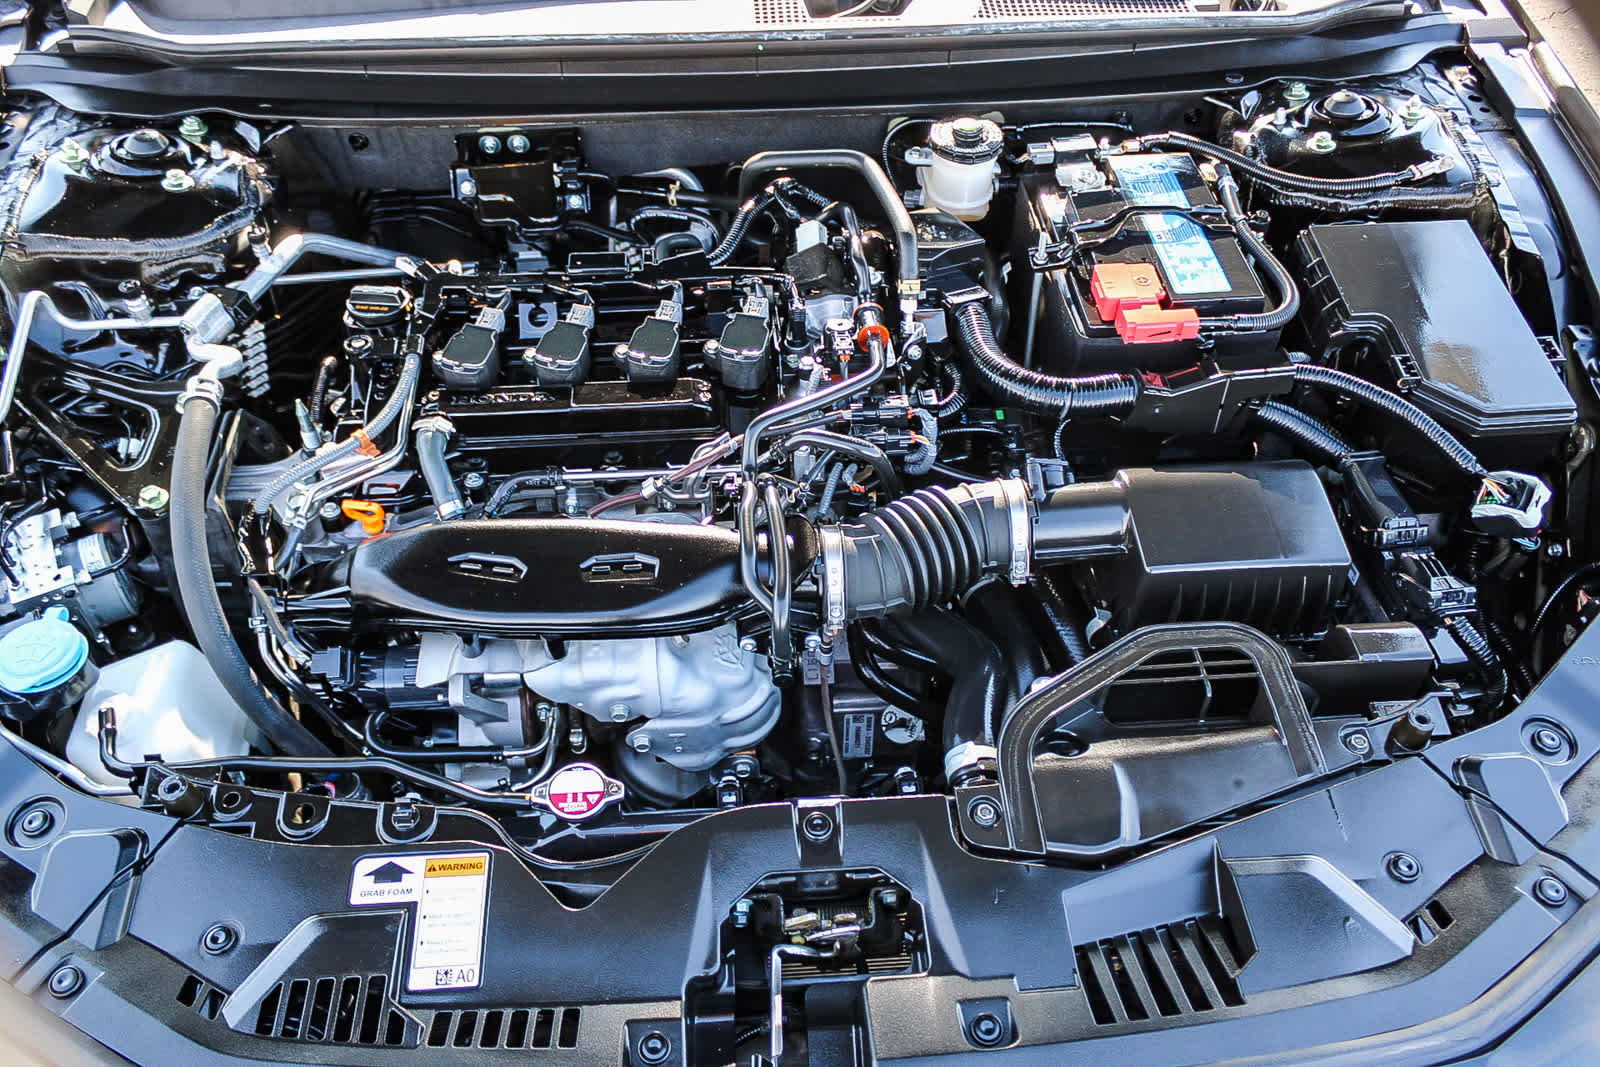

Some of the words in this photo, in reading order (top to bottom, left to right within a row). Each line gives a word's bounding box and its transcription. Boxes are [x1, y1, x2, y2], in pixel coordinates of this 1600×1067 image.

[438, 861, 483, 872] WARNING
[360, 889, 385, 898] GRAB
[387, 888, 413, 897] FOAM
